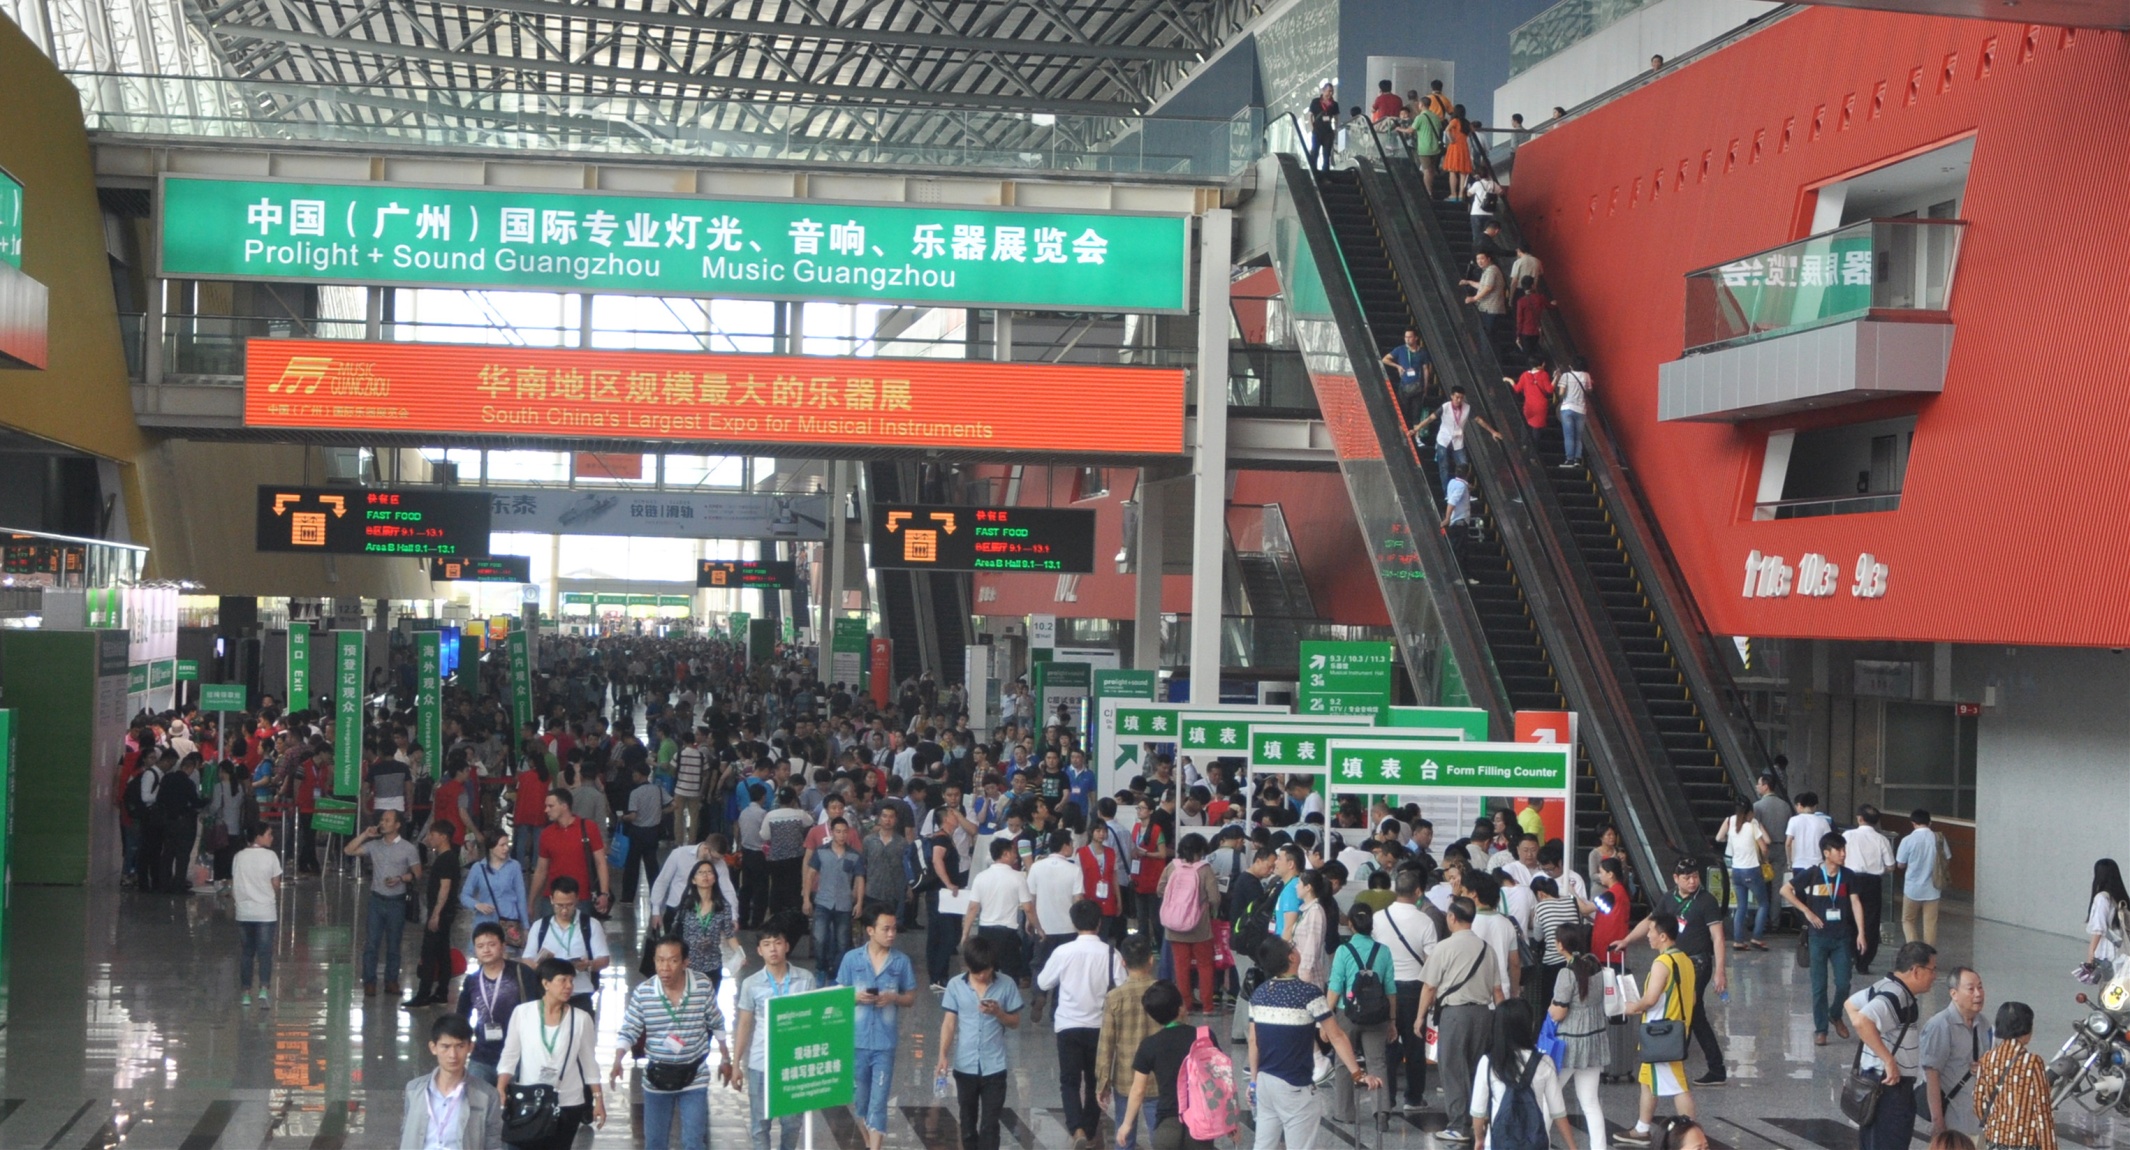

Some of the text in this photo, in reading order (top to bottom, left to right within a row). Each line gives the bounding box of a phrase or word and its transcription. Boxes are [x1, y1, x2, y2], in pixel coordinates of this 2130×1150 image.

[248, 197, 1109, 265] 中国（广州）国际专业灯光、音响、乐器展览会
[246, 240, 956, 291] Prolight + Sound Guangzhou Music Guangzhou
[337, 362, 377, 377] MUSIC
[331, 376, 390, 397] GUANGZHOU
[477, 363, 913, 412] 华南地区规模最大的乐器展
[481, 405, 993, 439] South China's Largest Expo for Musical Instruments
[366, 511, 422, 521] FAST FOOD
[975, 527, 1028, 537] FAST FOOD
[1797, 552, 1839, 597] 10.3
[1852, 552, 1889, 598] 9.3
[1034, 622, 1053, 631] 10.2
[294, 633, 304, 660] 出口
[342, 644, 356, 713] 预登记观众
[423, 645, 435, 706] 海外观众
[513, 642, 526, 696] 国内观众
[294, 670, 304, 692] Exit
[425, 711, 433, 749] Overseas
[1124, 715, 1168, 731] 填表
[1189, 727, 1237, 744] 填表
[1263, 741, 1316, 760] 填表
[1342, 757, 1439, 780] 填表台
[1447, 765, 1558, 778] Form Filling Counter
[794, 1042, 829, 1061] 现场登记
